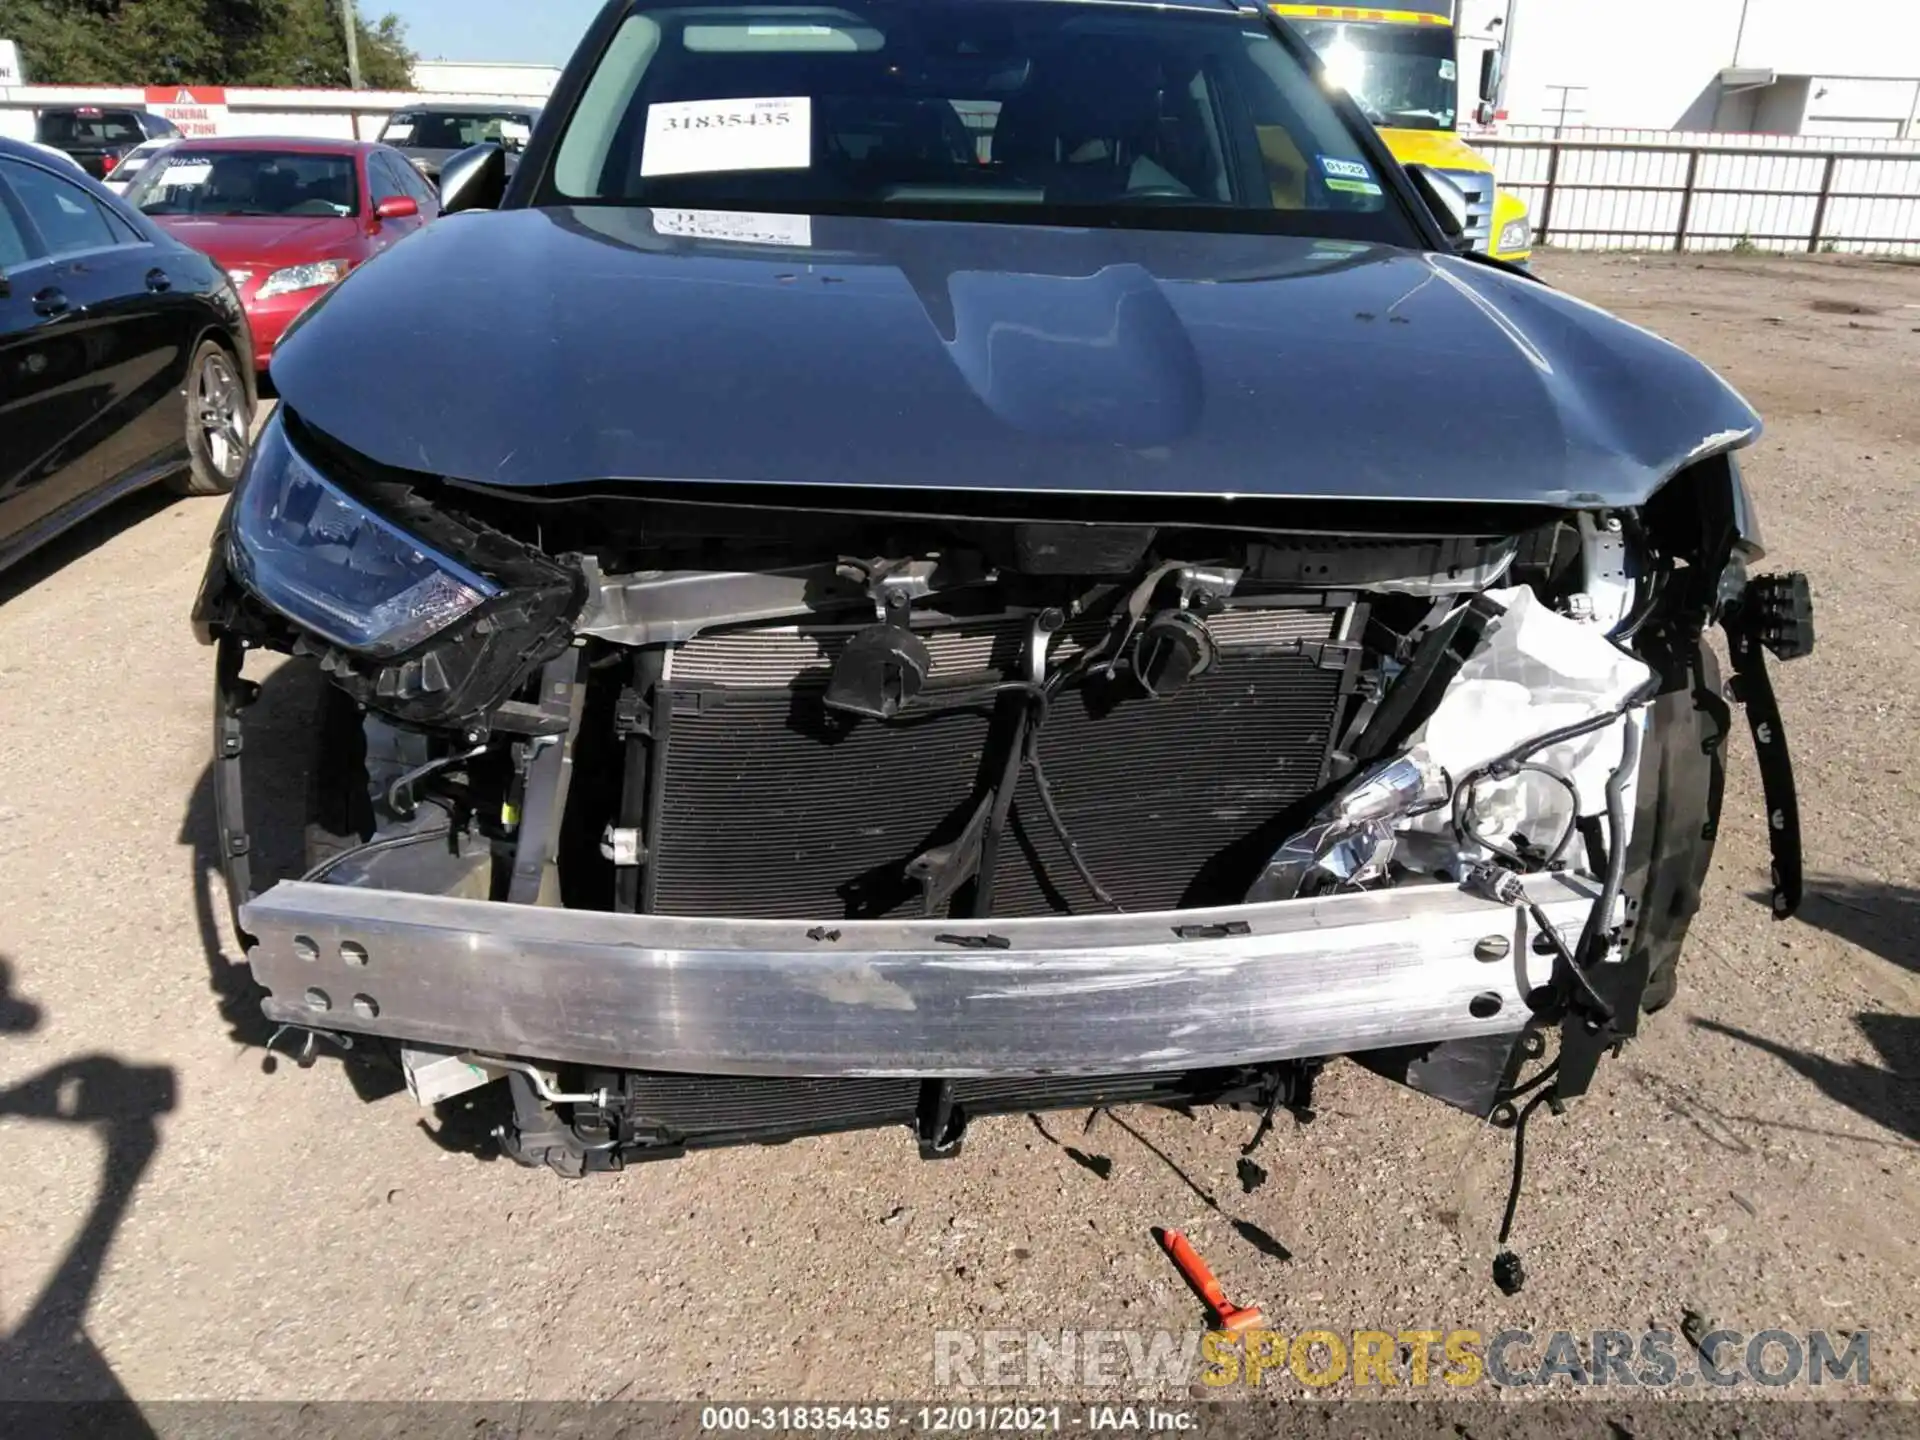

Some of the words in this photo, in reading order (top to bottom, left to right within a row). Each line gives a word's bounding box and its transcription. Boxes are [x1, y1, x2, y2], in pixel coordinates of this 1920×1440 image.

[165, 107, 208, 120] GENERAL
[663, 112, 790, 131] 31835435
[192, 123, 217, 136] ZONE
